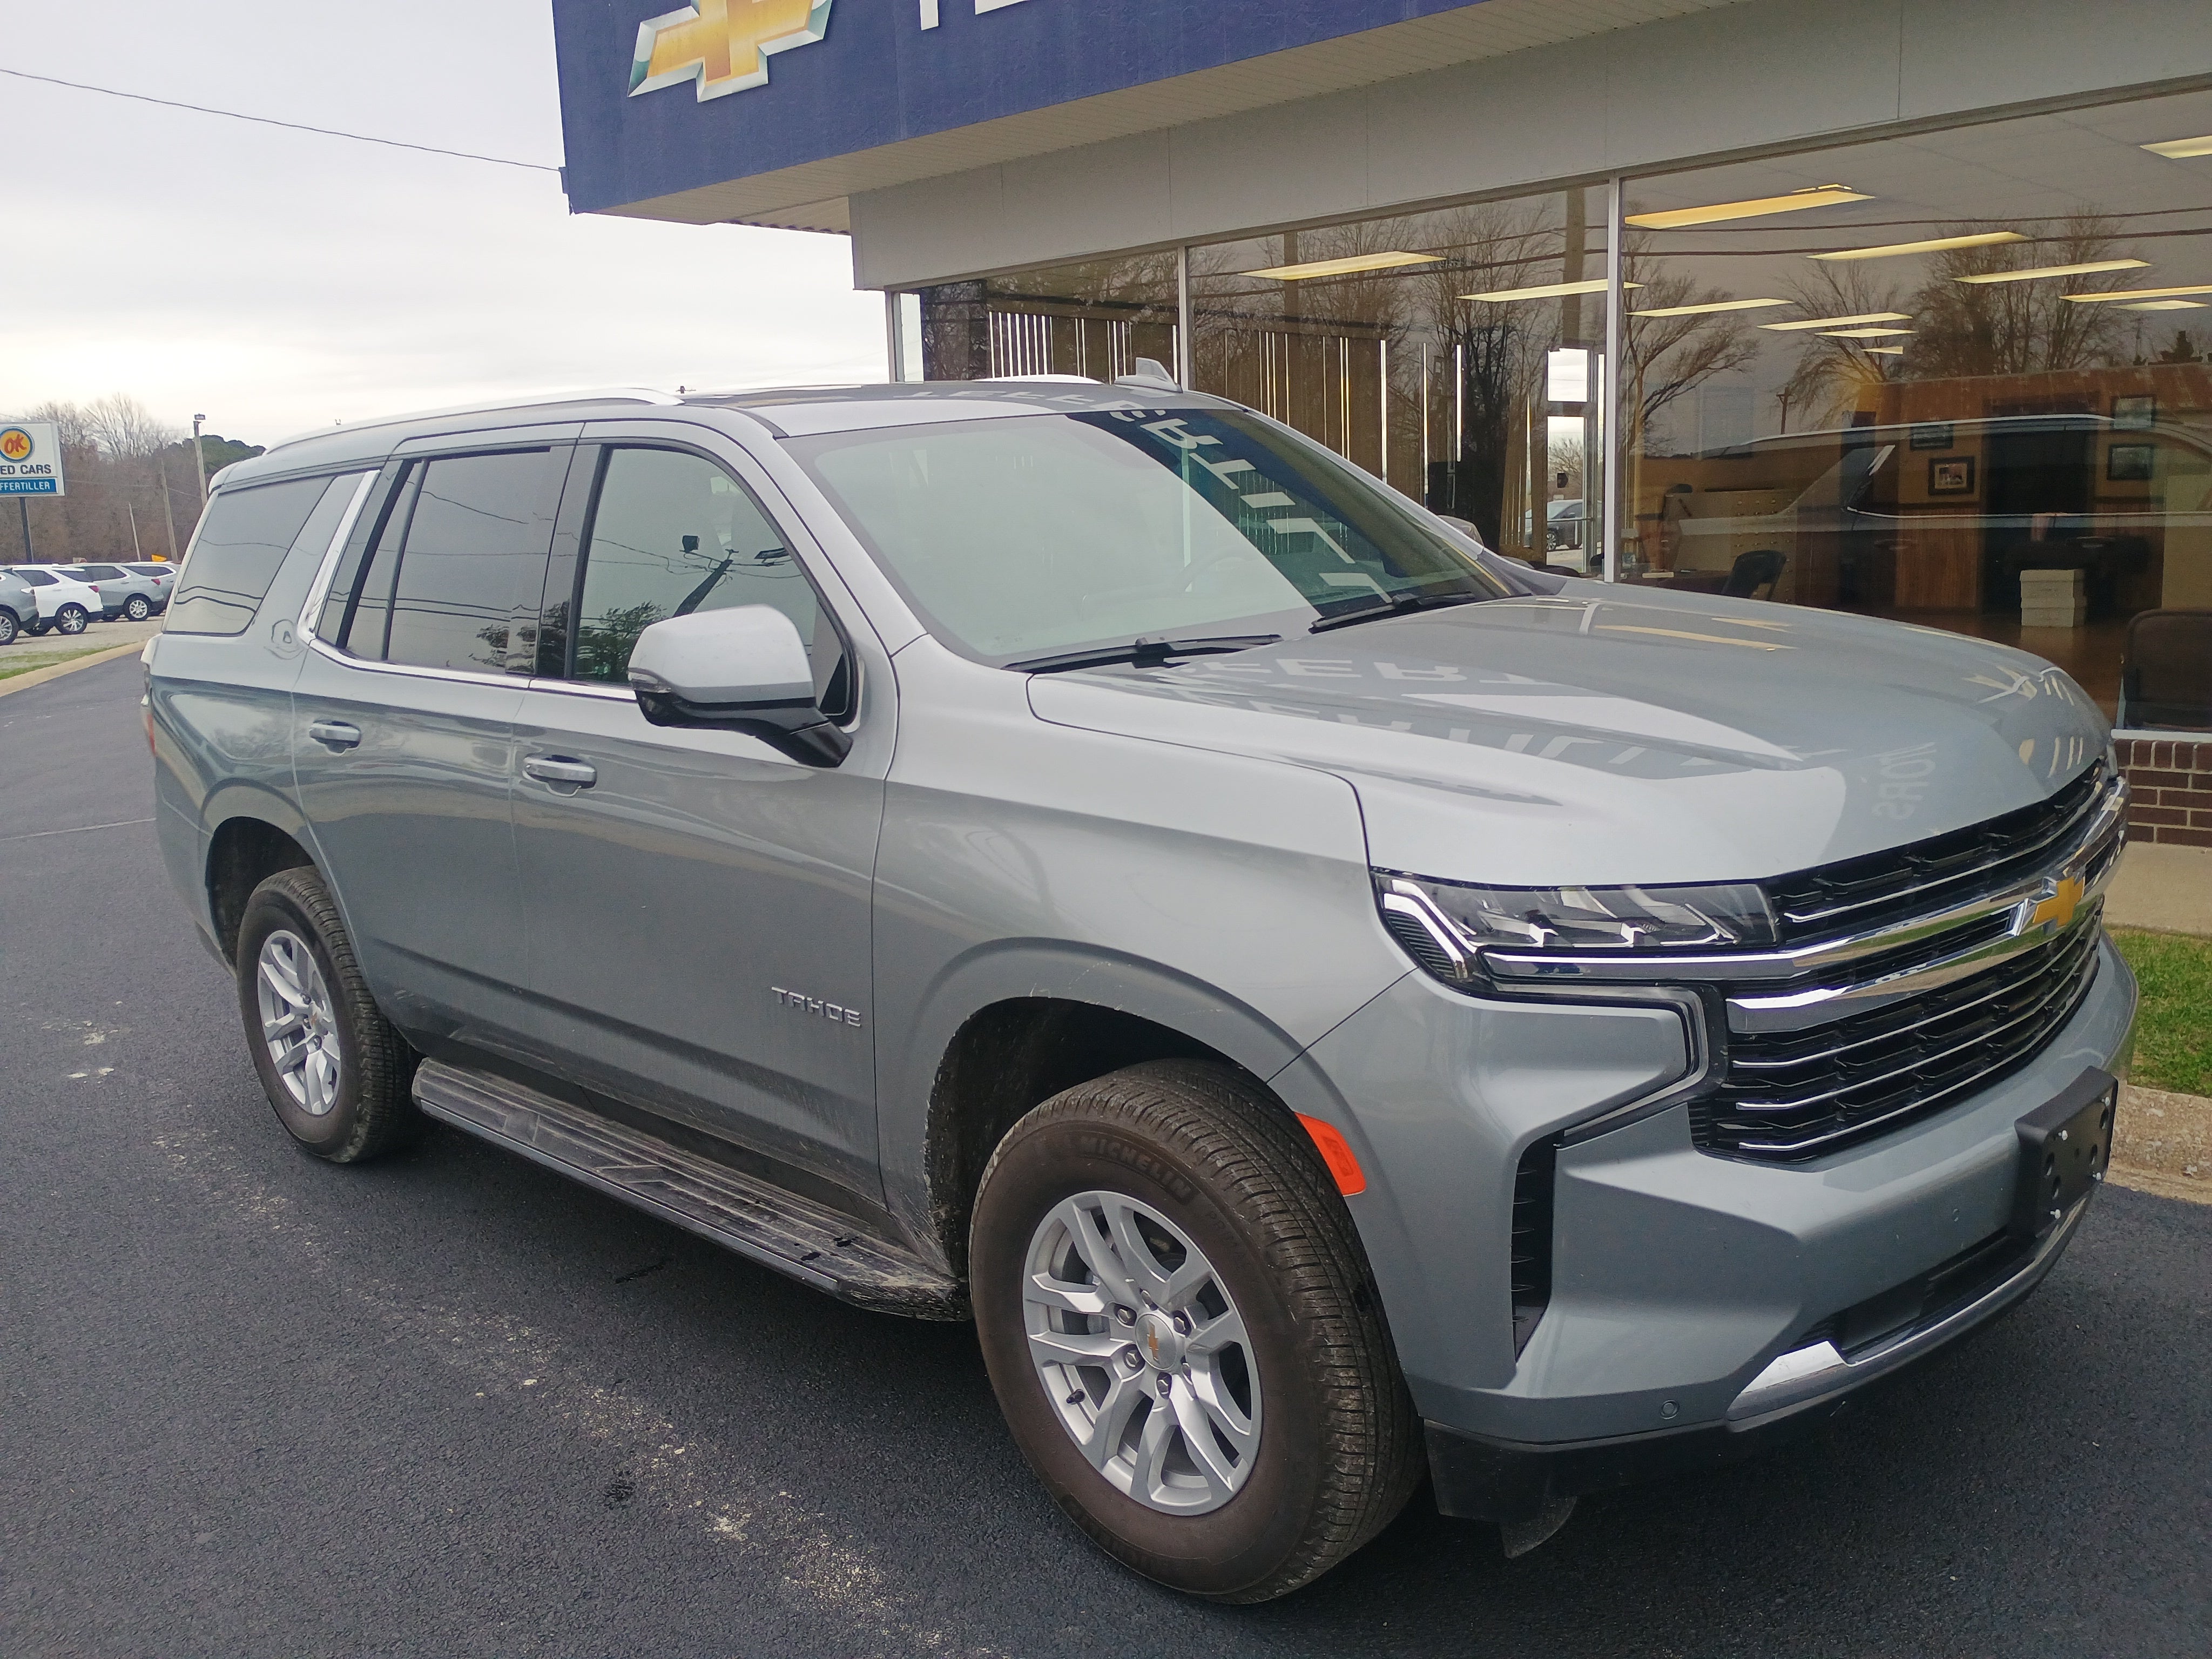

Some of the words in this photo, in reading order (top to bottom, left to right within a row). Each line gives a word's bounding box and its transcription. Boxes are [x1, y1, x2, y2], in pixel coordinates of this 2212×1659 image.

[4, 434, 27, 454] OK
[20, 464, 52, 475] CARS
[771, 986, 861, 1027] TAHOE
[1080, 1135, 1192, 1199] MICHELIN
